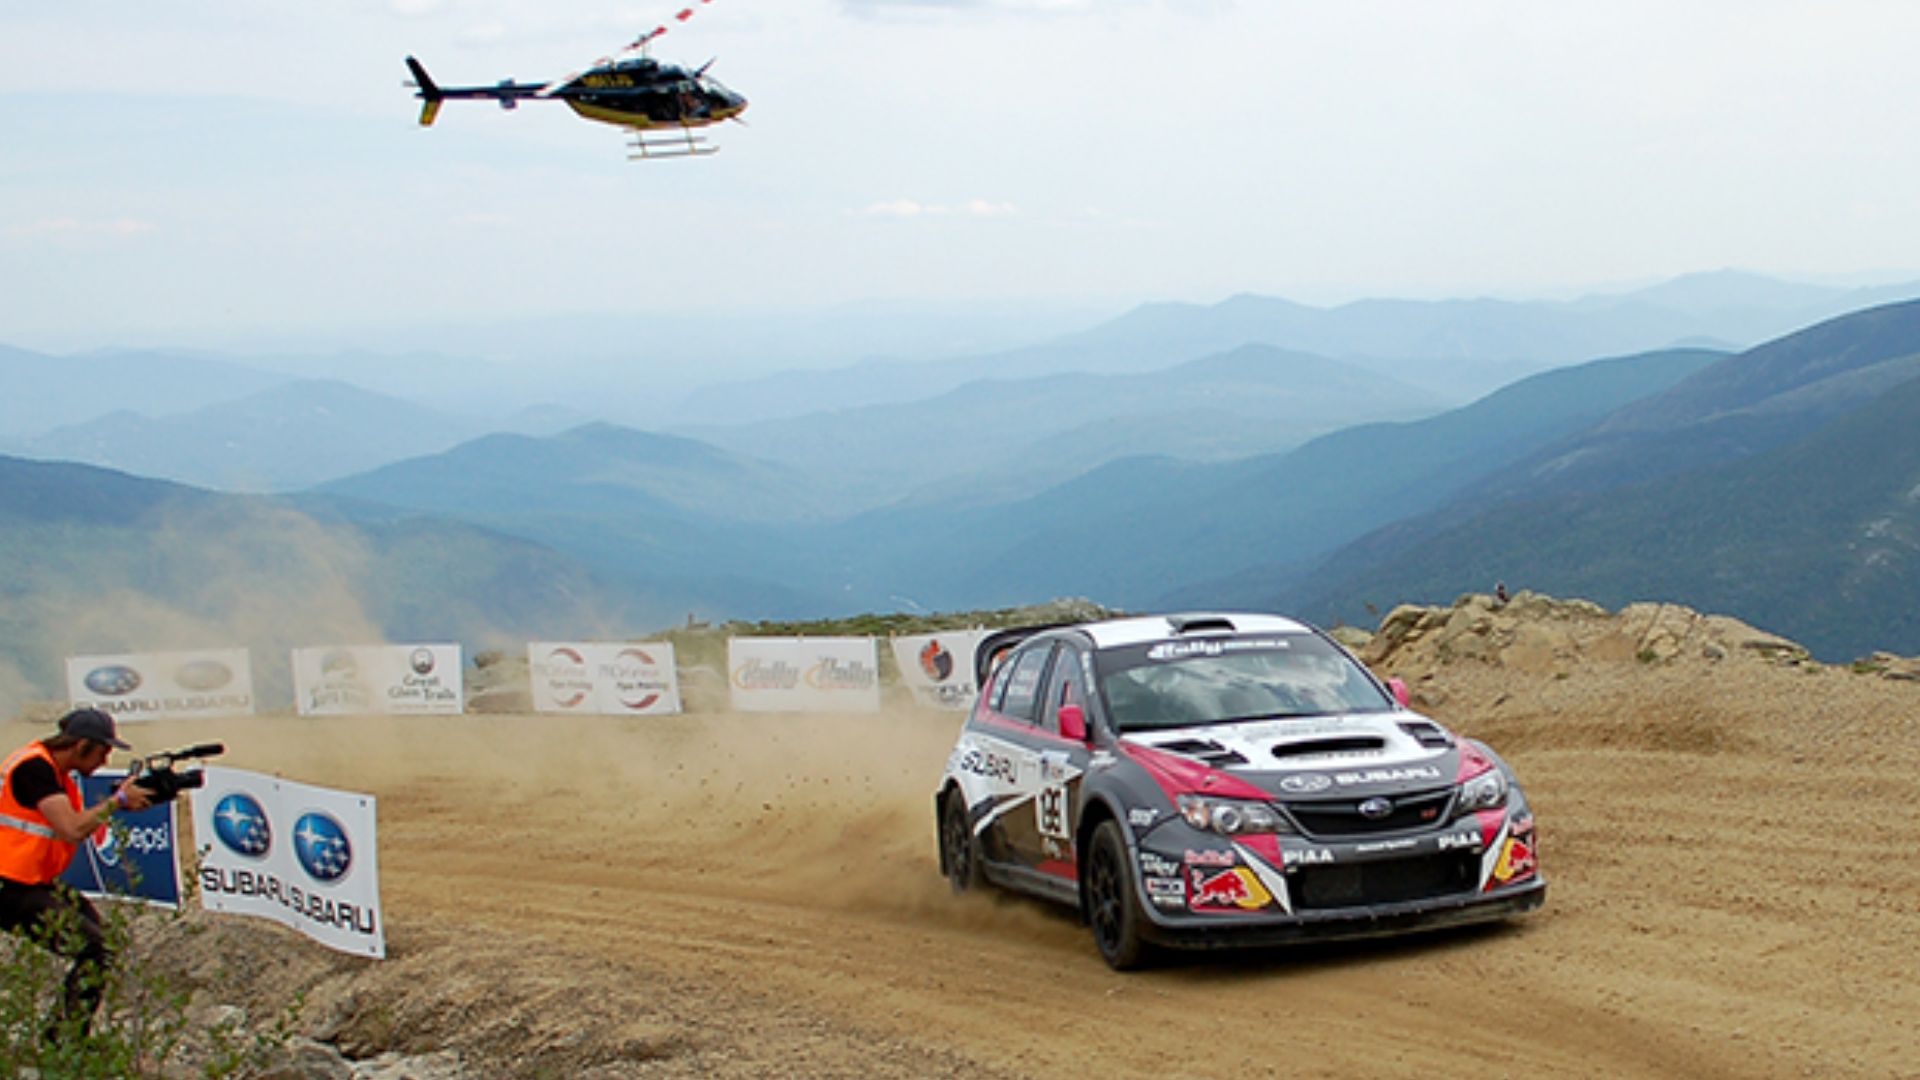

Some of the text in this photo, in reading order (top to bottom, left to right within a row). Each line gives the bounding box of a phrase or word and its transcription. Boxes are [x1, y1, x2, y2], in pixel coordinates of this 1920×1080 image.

[1336, 767, 1441, 786] SUBARU
[1438, 832, 1481, 849] PIAA
[1283, 848, 1334, 865] PIAA
[202, 867, 375, 934] SUBARU SUBARU
